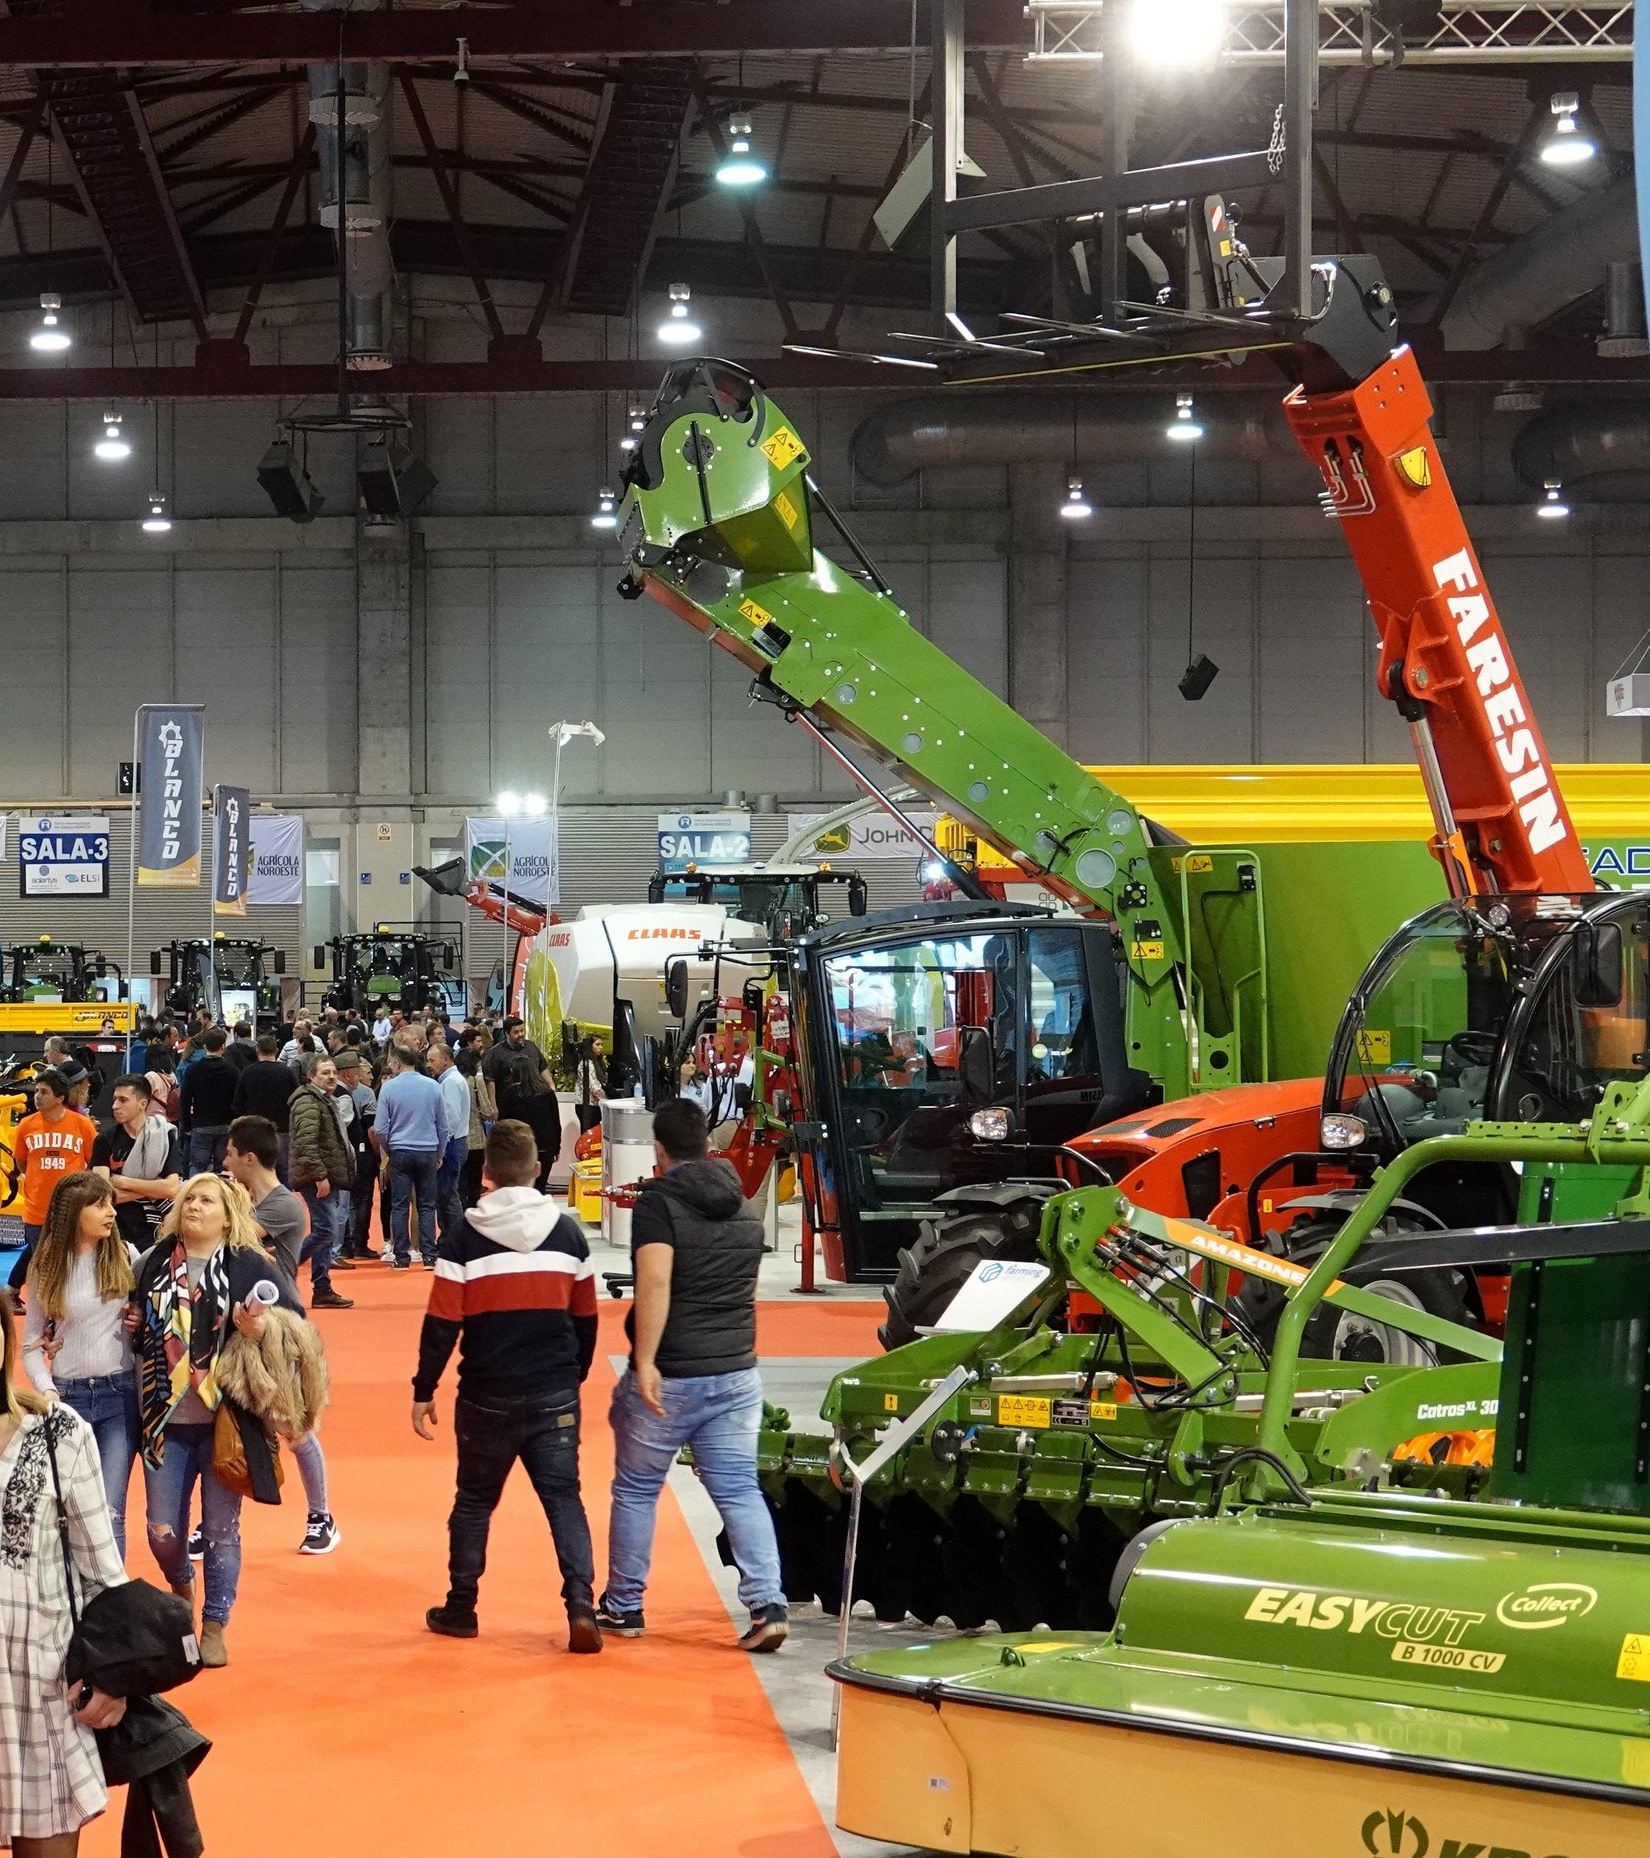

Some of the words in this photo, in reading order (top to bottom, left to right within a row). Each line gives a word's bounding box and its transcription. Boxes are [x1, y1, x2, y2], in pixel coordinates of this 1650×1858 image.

[1432, 547, 1567, 856] FARESIN
[162, 739, 183, 859] BLANCO
[660, 835, 749, 858] SALA-2
[859, 827, 913, 844] JOHN
[21, 837, 109, 861] SALA-3
[227, 810, 240, 896] BLANCO
[257, 854, 299, 866] AGRÍCOLA
[1581, 846, 1650, 875] AD
[257, 867, 299, 877] NOROESTE
[548, 933, 571, 947] CLAAS
[627, 928, 702, 940] CLAAS
[25, 1132, 84, 1153] ADIDAS
[40, 1157, 66, 1170] 1949
[1005, 1264, 1044, 1278] farming
[1190, 1235, 1309, 1287] AMAZONE
[1511, 1596, 1582, 1613] Collect
[1245, 1588, 1486, 1645] EASYCUT
[1401, 1641, 1413, 1660] B
[1421, 1644, 1465, 1667] 1000
[1469, 1652, 1496, 1671] CV
